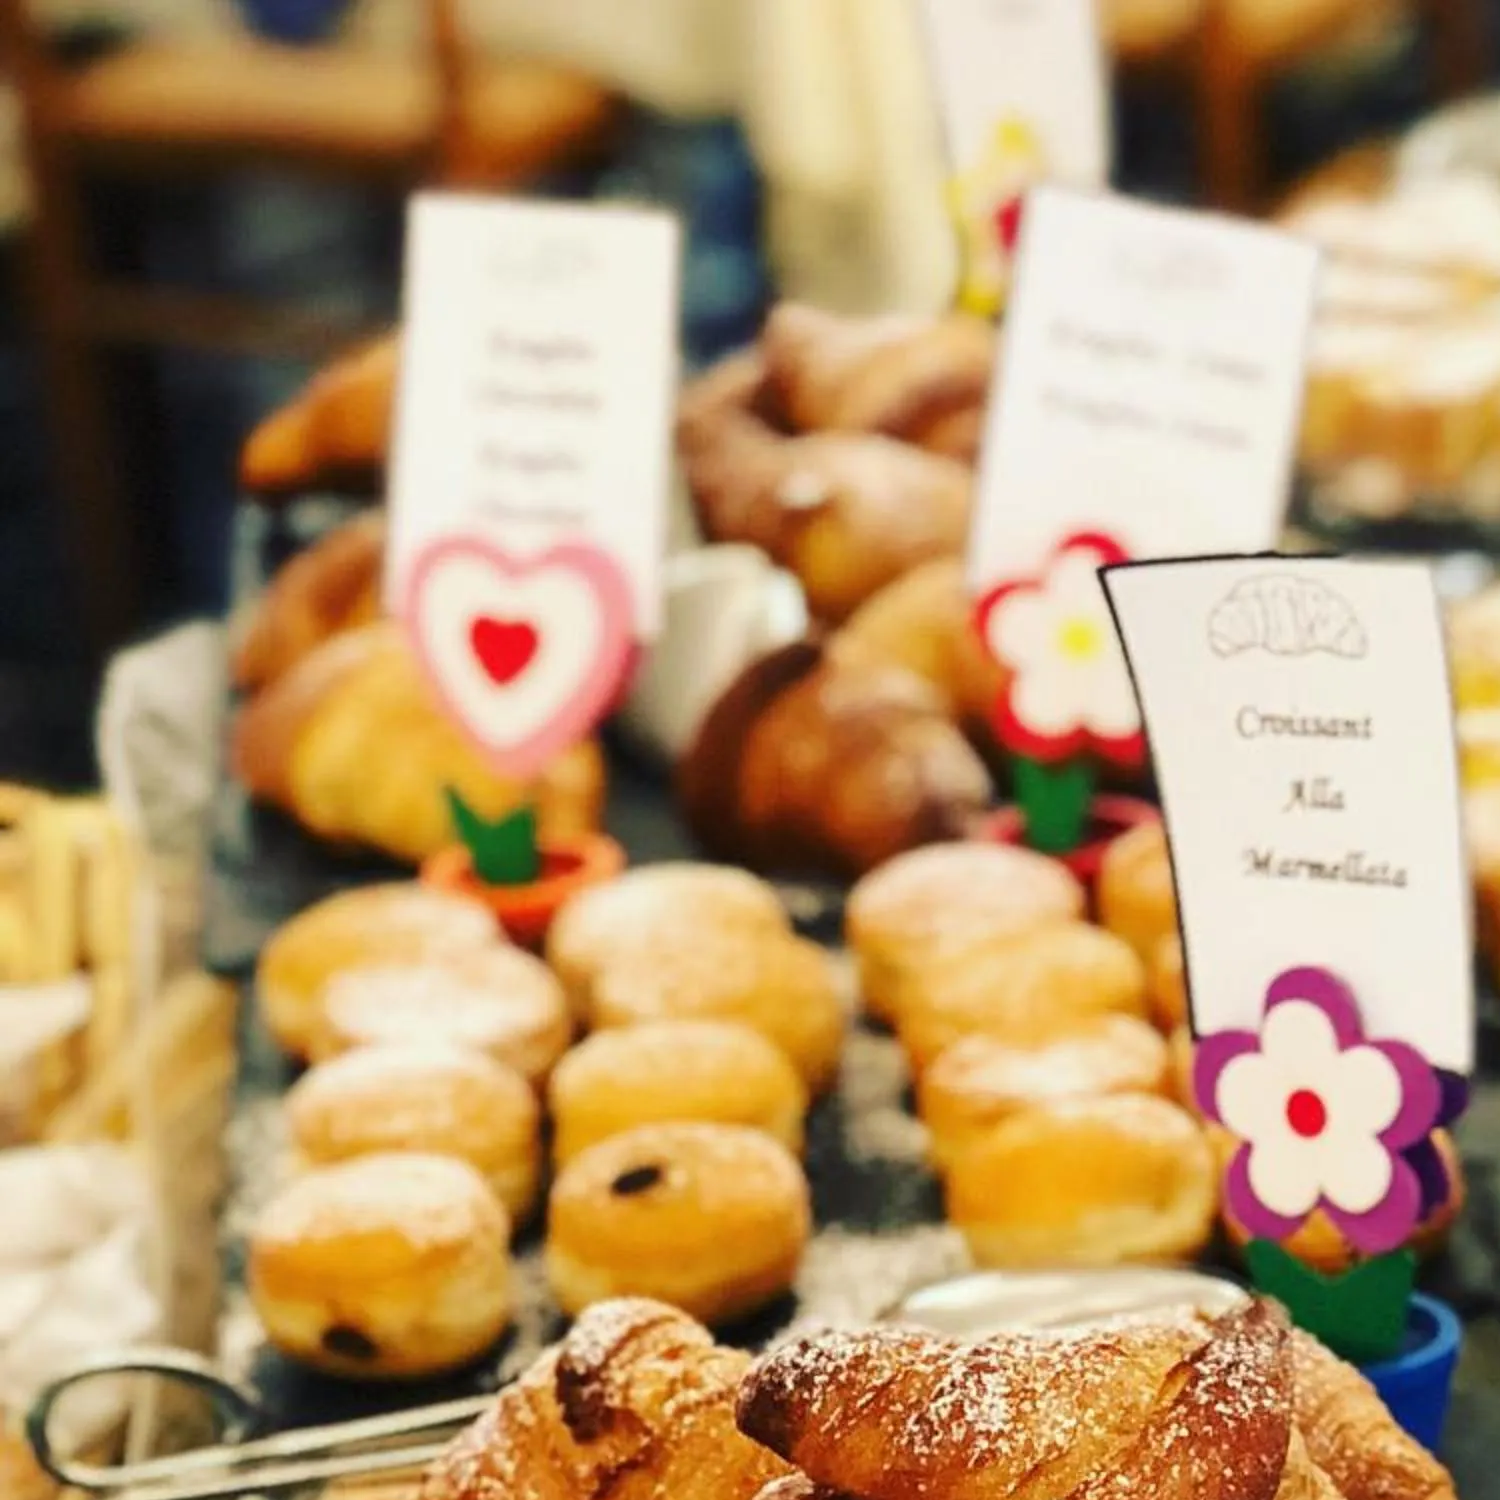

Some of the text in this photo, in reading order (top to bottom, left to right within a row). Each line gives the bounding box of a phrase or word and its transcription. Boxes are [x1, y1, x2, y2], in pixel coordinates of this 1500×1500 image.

[1235, 705, 1373, 740] Croissant
[1282, 777, 1345, 813] Alla
[1243, 848, 1409, 888] Marmellata
